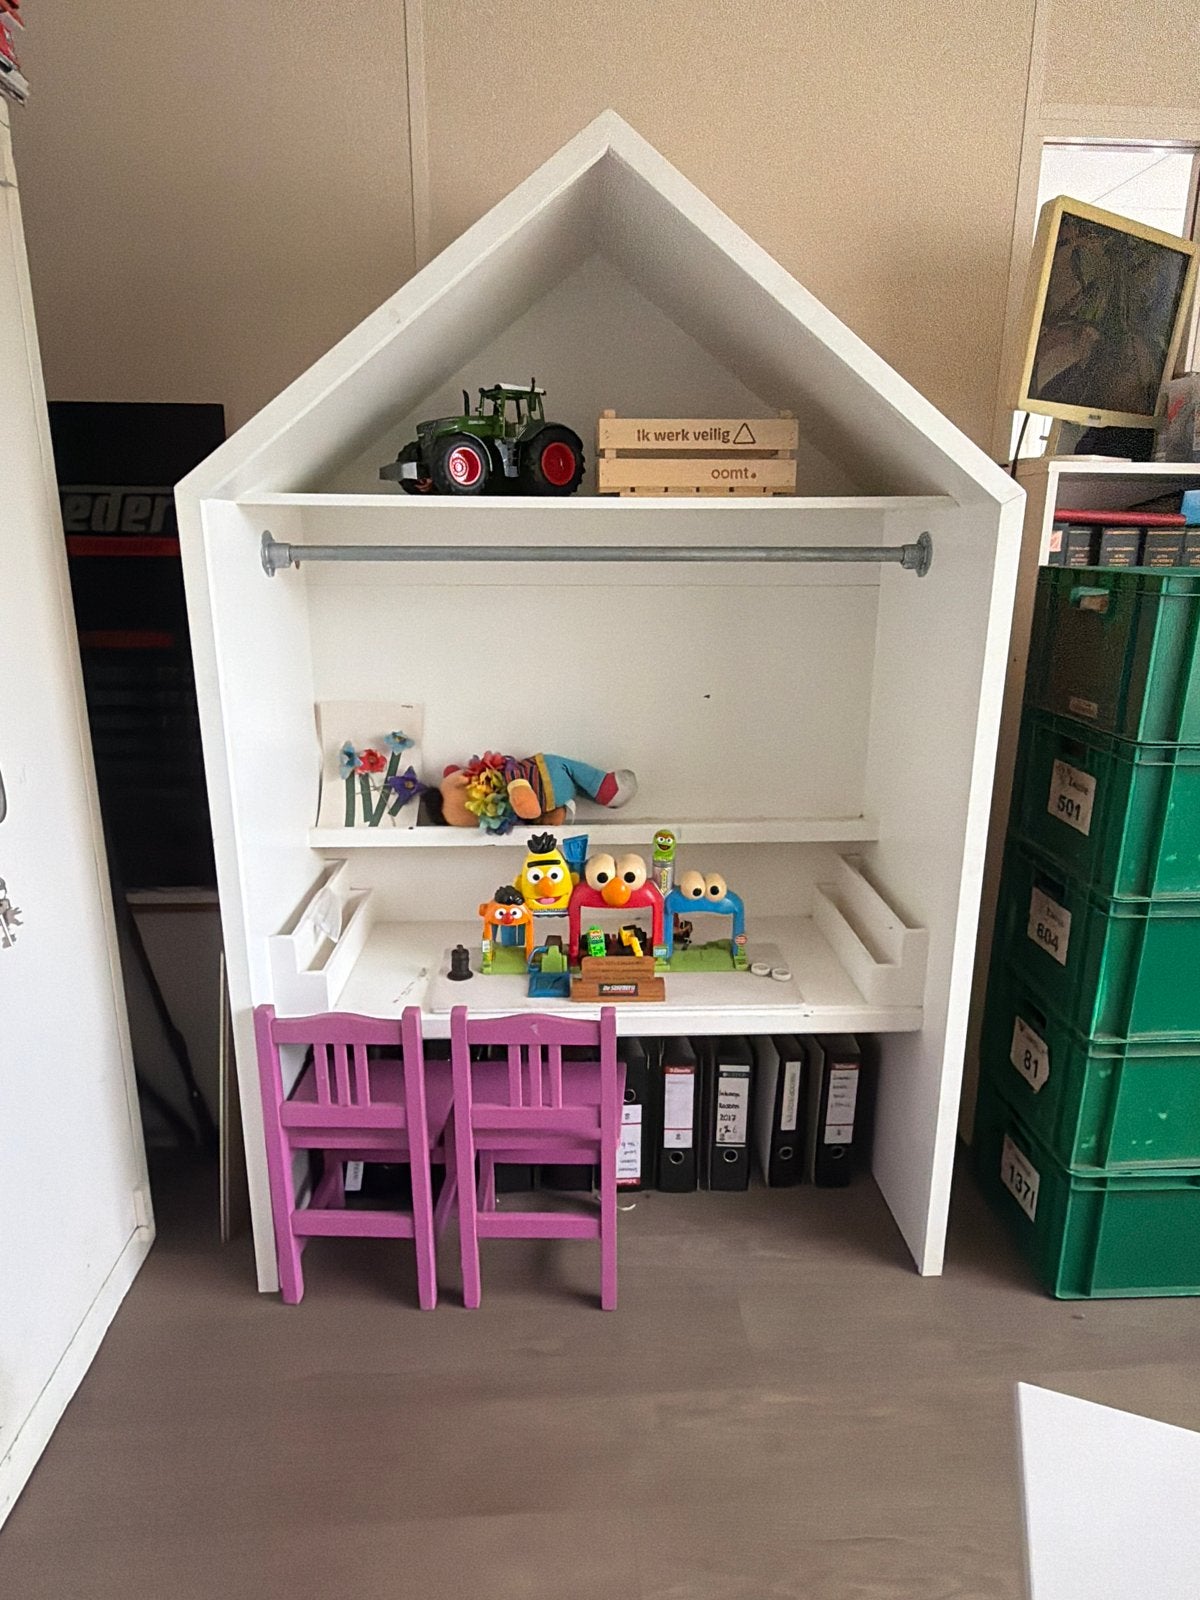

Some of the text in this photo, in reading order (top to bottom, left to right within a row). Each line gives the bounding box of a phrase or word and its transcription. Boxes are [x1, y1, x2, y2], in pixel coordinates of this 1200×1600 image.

[636, 427, 731, 444] Ik werk veilig
[711, 467, 757, 480] oomt.
[1057, 794, 1081, 821] 501
[1023, 1049, 1039, 1078] 81
[1008, 1165, 1035, 1210] 1371
